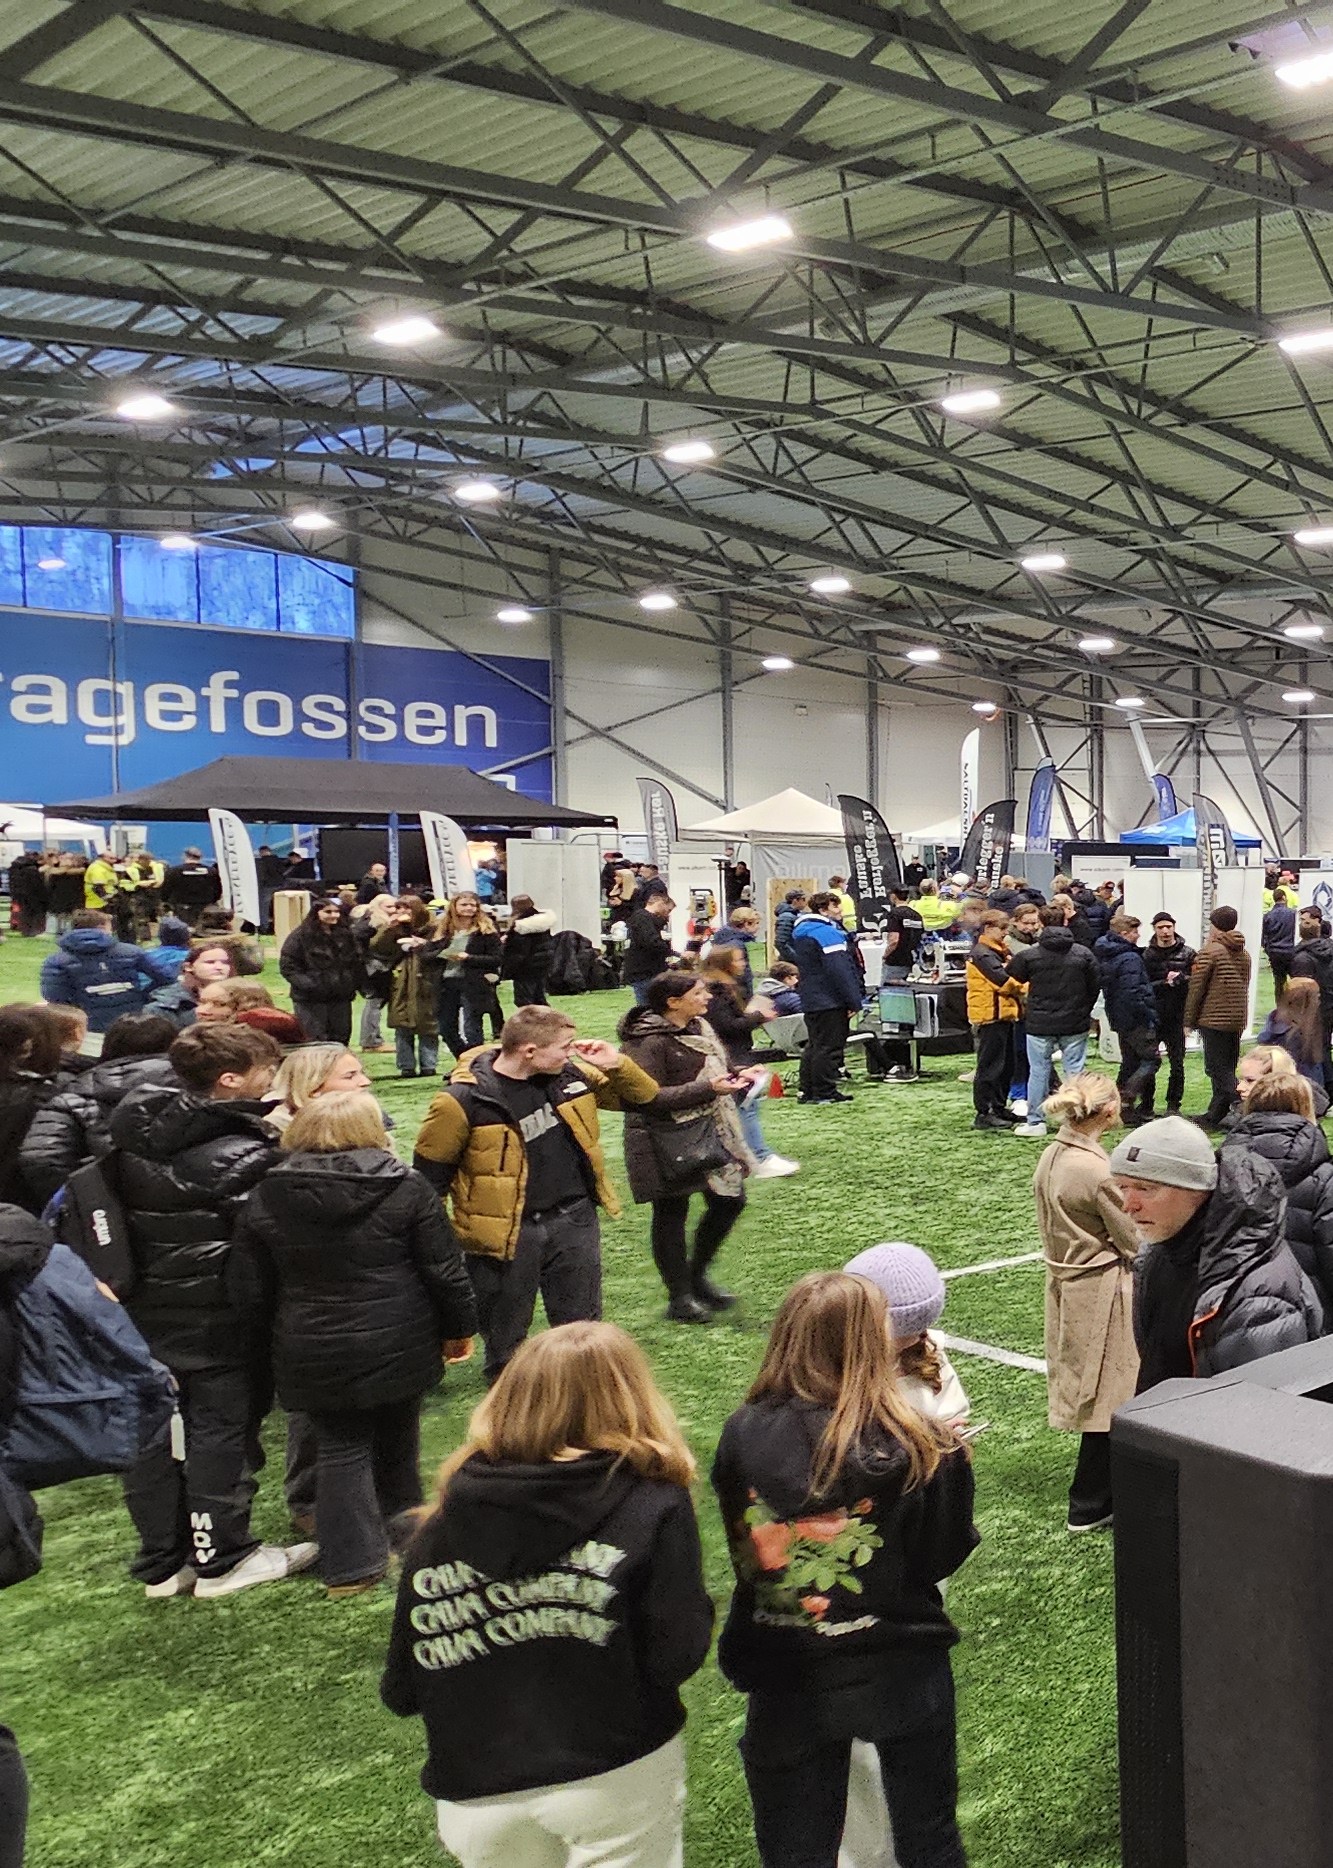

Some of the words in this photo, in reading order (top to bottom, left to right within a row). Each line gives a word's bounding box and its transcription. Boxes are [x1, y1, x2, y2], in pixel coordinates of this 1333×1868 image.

[0, 671, 498, 748] agefossen
[990, 846, 1004, 888] auske
[92, 1208, 112, 1246] umbro
